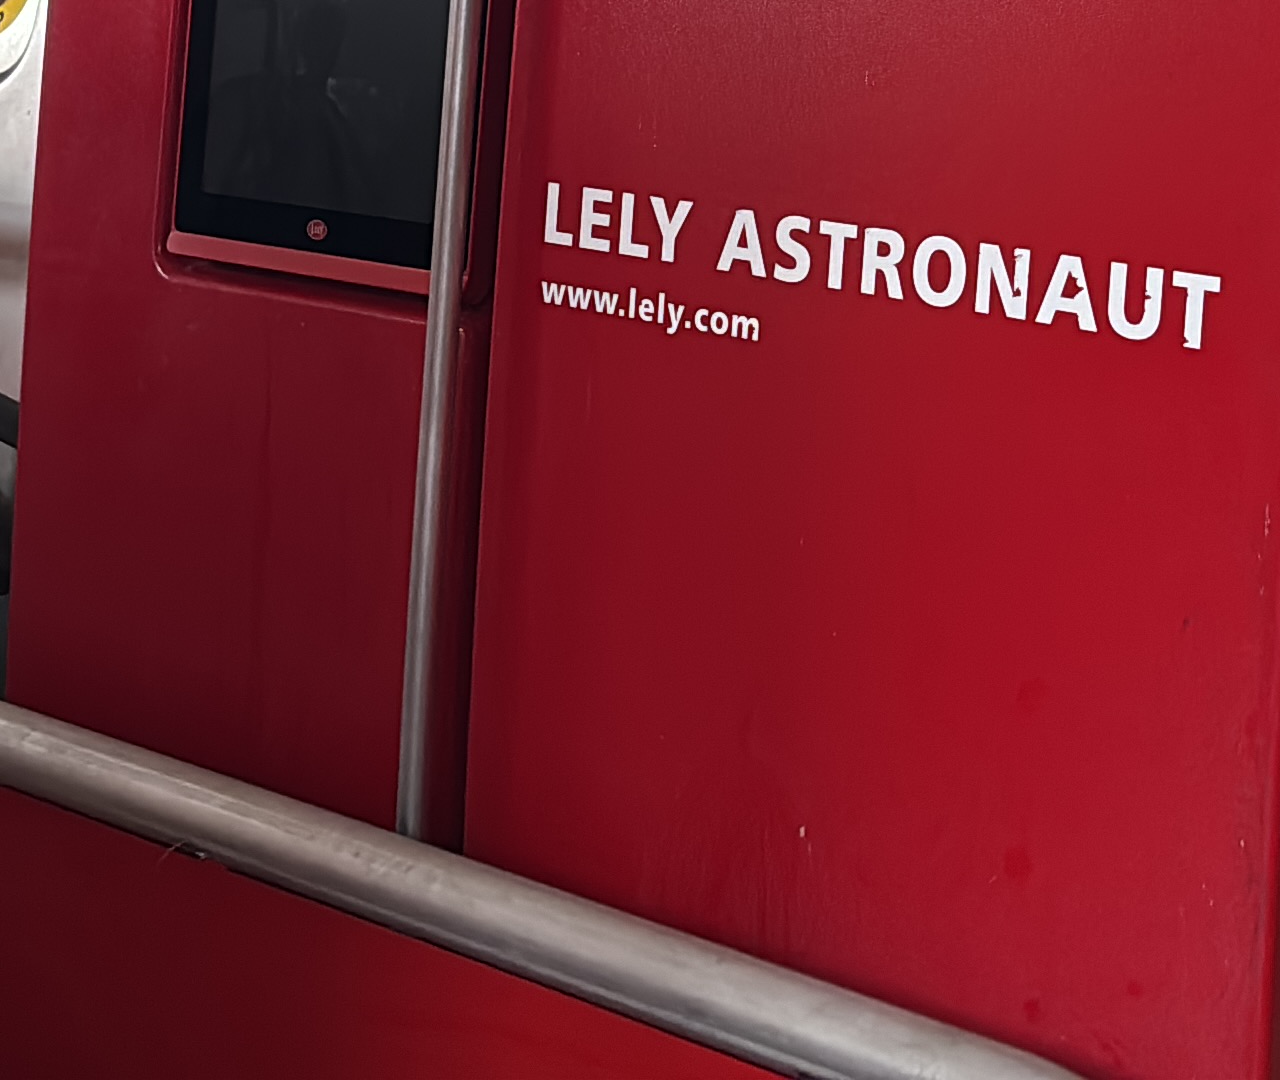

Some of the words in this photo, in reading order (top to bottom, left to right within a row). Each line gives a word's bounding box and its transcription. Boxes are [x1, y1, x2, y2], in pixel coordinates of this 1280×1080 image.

[541, 280, 760, 342] www.lely.com
[543, 181, 694, 263] LELY
[716, 208, 1222, 350] ASTRONAUT
